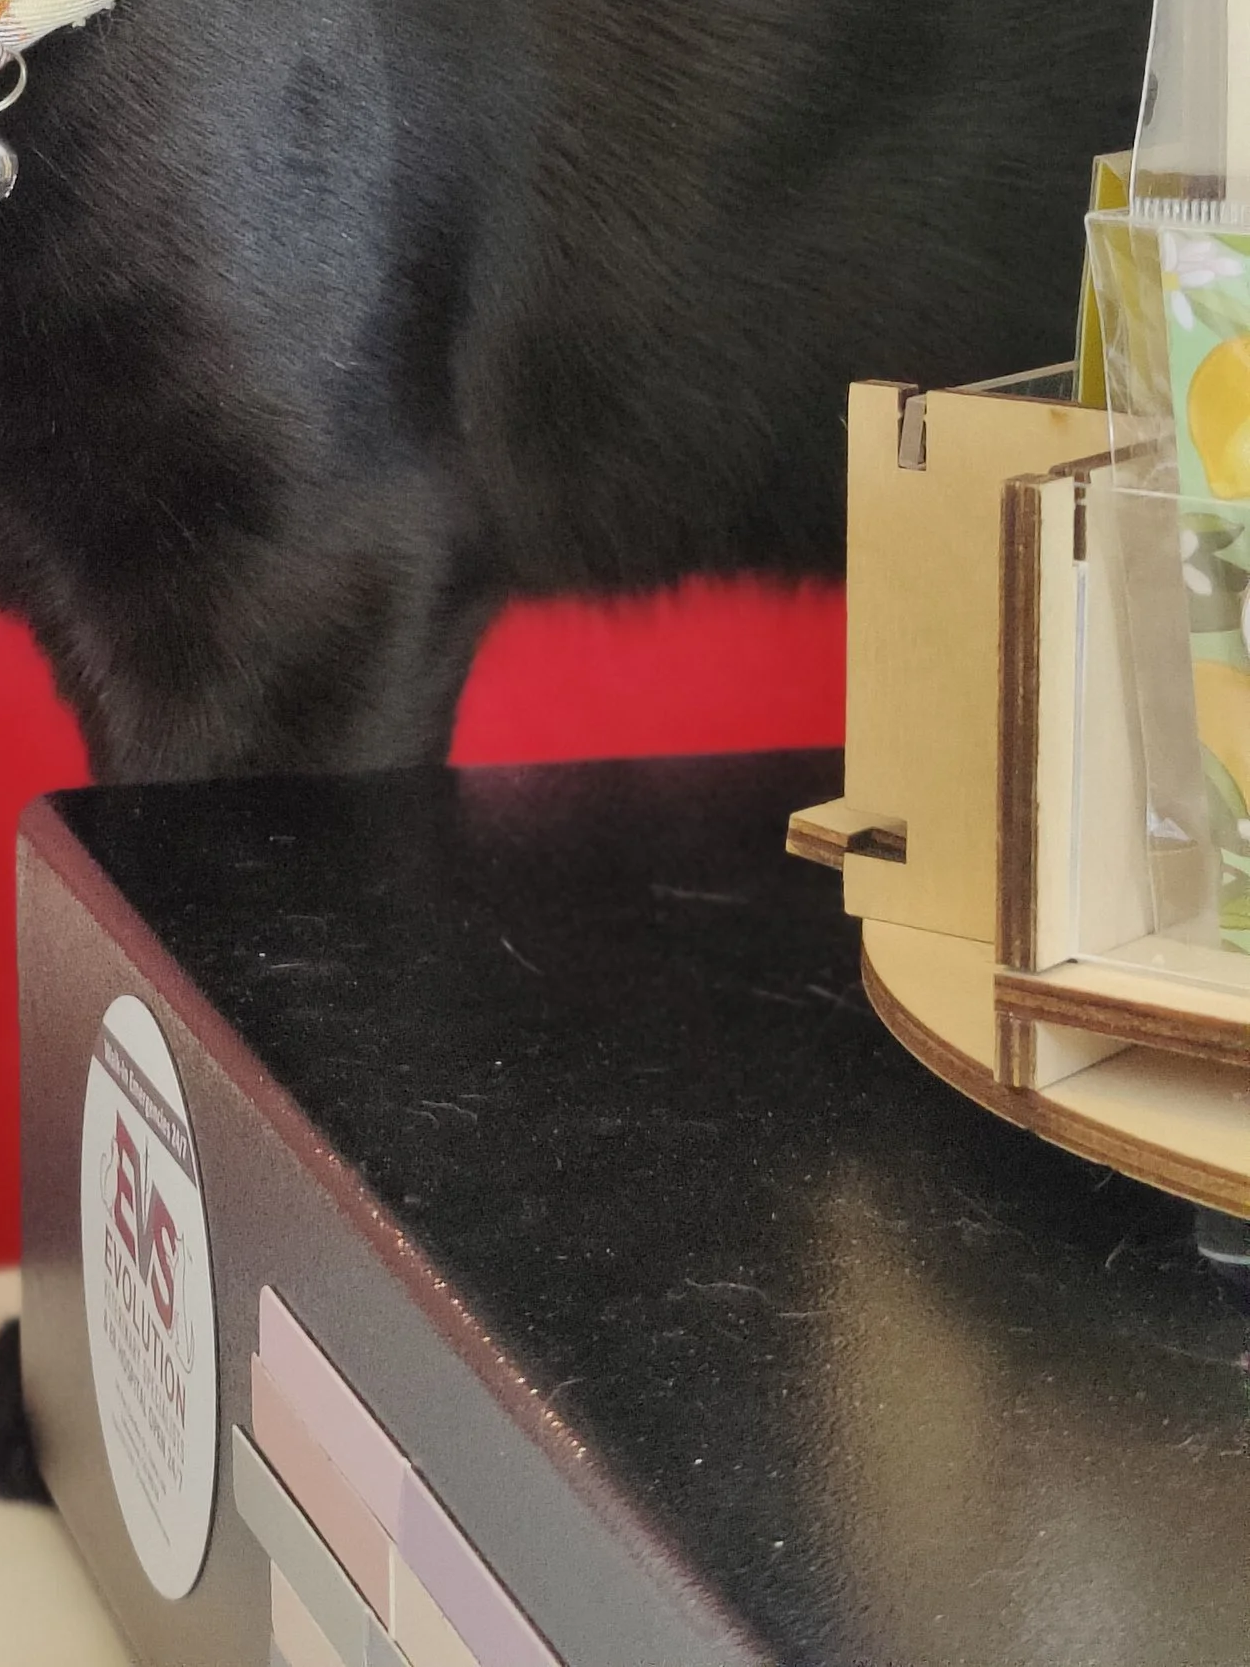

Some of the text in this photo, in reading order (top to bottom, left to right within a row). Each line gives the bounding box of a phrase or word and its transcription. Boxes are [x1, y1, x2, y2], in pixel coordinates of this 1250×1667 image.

[129, 1070, 170, 1141] Emergencies
[171, 1122, 187, 1160] 24/7
[114, 1109, 177, 1331] EVS
[104, 1222, 186, 1430] EVOLUTION
[167, 1446, 182, 1493] 24/7
